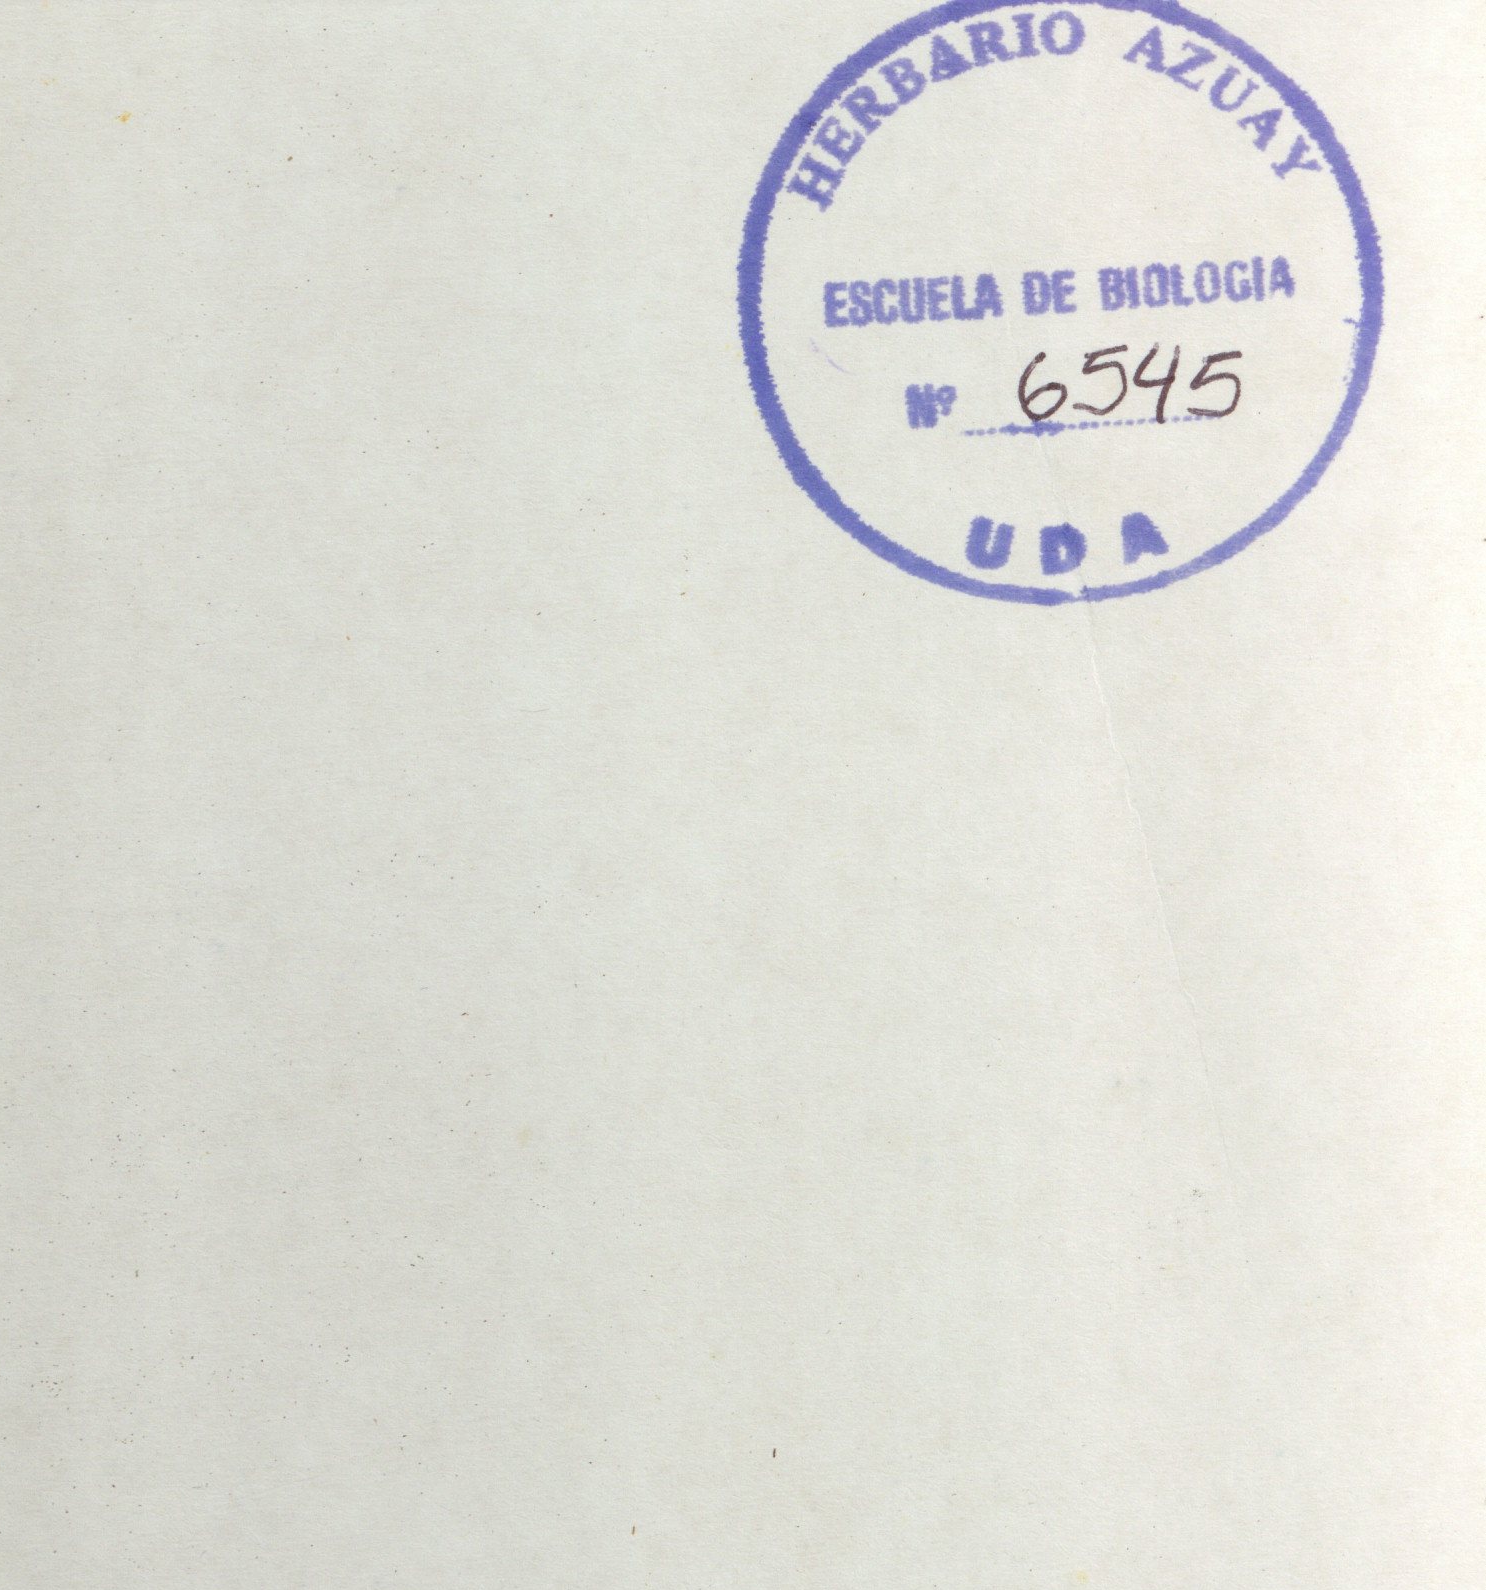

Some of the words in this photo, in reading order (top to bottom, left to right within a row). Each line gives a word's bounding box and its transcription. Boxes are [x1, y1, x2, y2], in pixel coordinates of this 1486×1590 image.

[786, 11, 1086, 212] HERBARIO
[1123, 25, 1323, 182] AZUAY
[823, 273, 1004, 328] ESCUELA
[1023, 270, 1077, 317] DE
[1016, 342, 1242, 423] 6545
